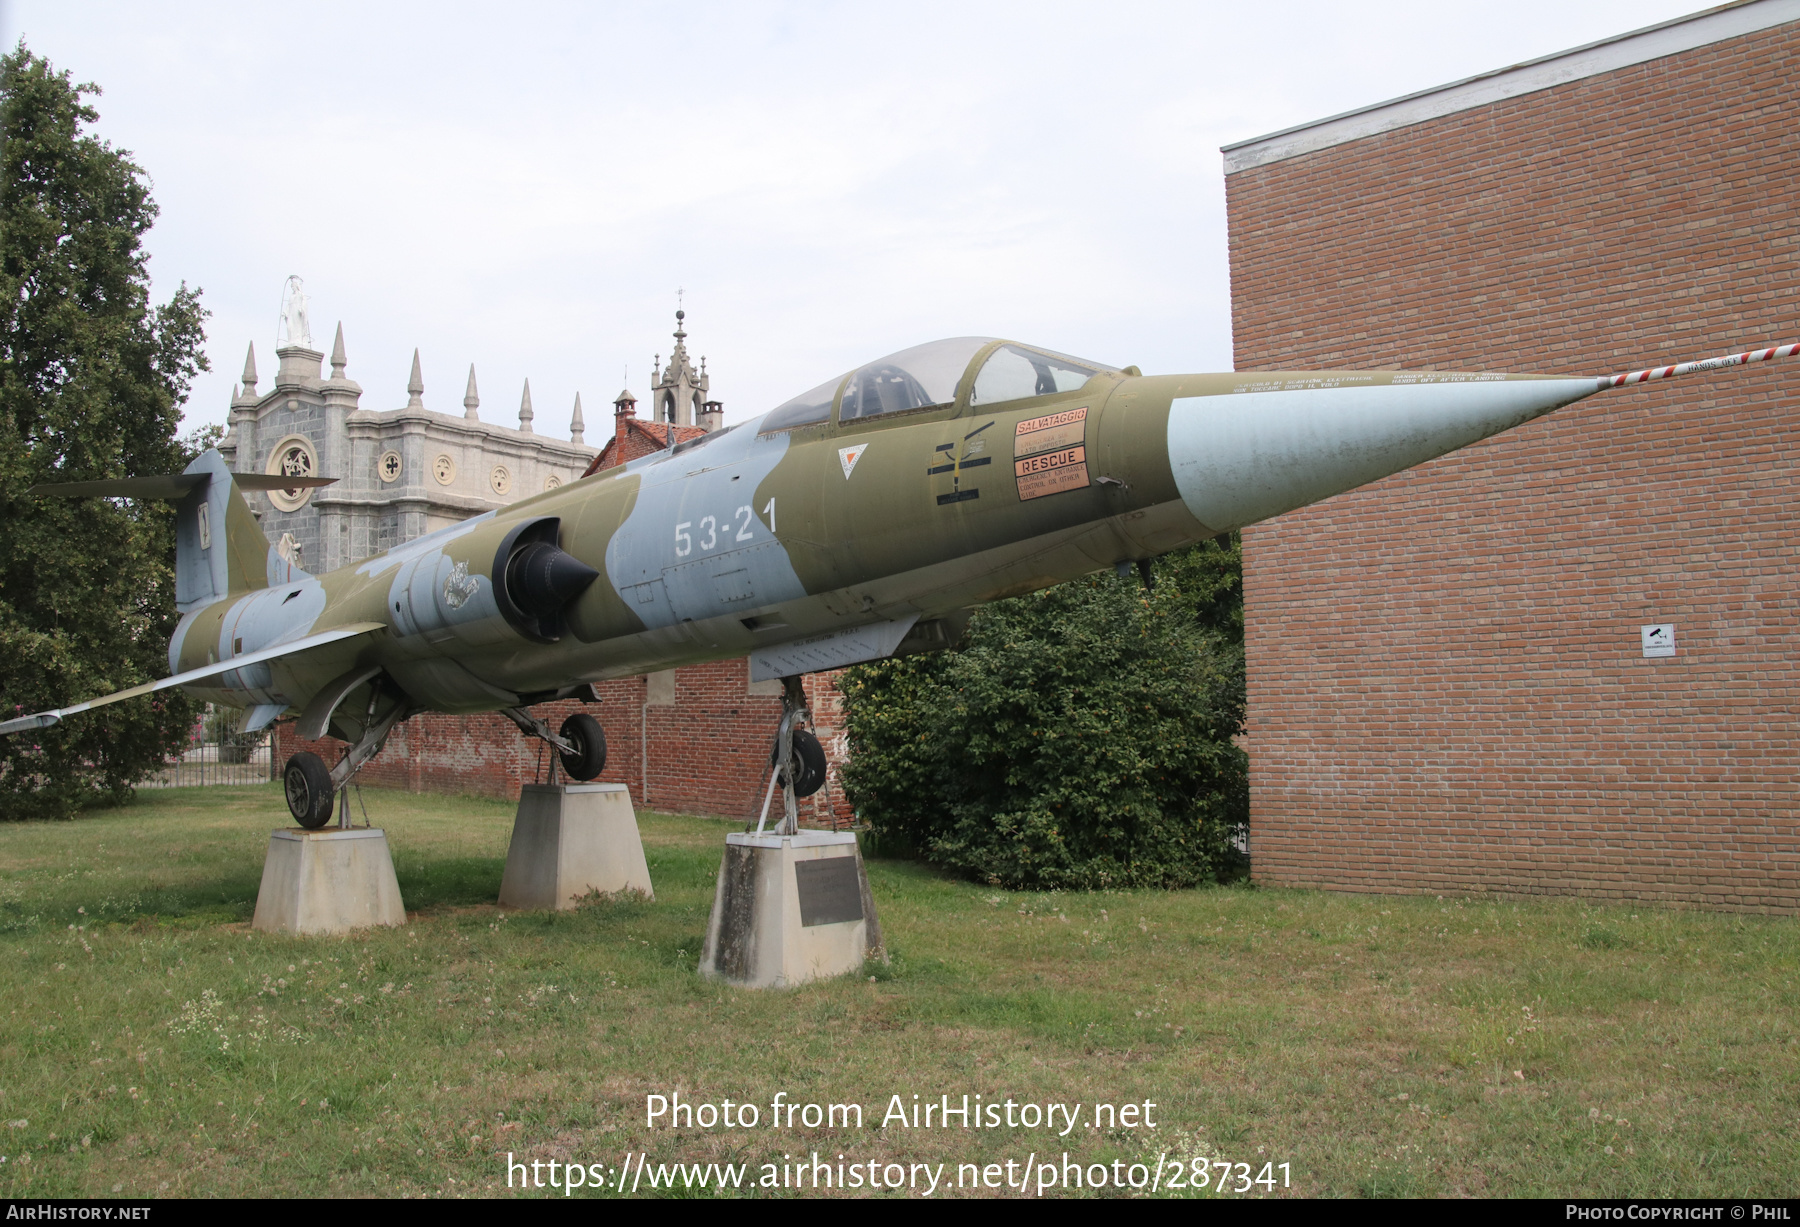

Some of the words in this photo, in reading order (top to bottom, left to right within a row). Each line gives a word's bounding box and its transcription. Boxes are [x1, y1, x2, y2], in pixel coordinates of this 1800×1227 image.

[1687, 361, 1717, 372] HANDS
[1721, 356, 1739, 367] OFF
[1018, 410, 1085, 433] SALVATAGGIO
[1020, 445, 1036, 454] LATO
[1038, 439, 1066, 450] OPPOSTO
[1022, 451, 1076, 473] RESCUE
[1018, 471, 1052, 484] EMERGENCY
[1054, 464, 1085, 476] ENTRANCE
[1019, 481, 1046, 491] CONTROL
[1059, 473, 1080, 483] OTHER
[1020, 490, 1037, 499] SIDE
[675, 497, 776, 557] 53-21
